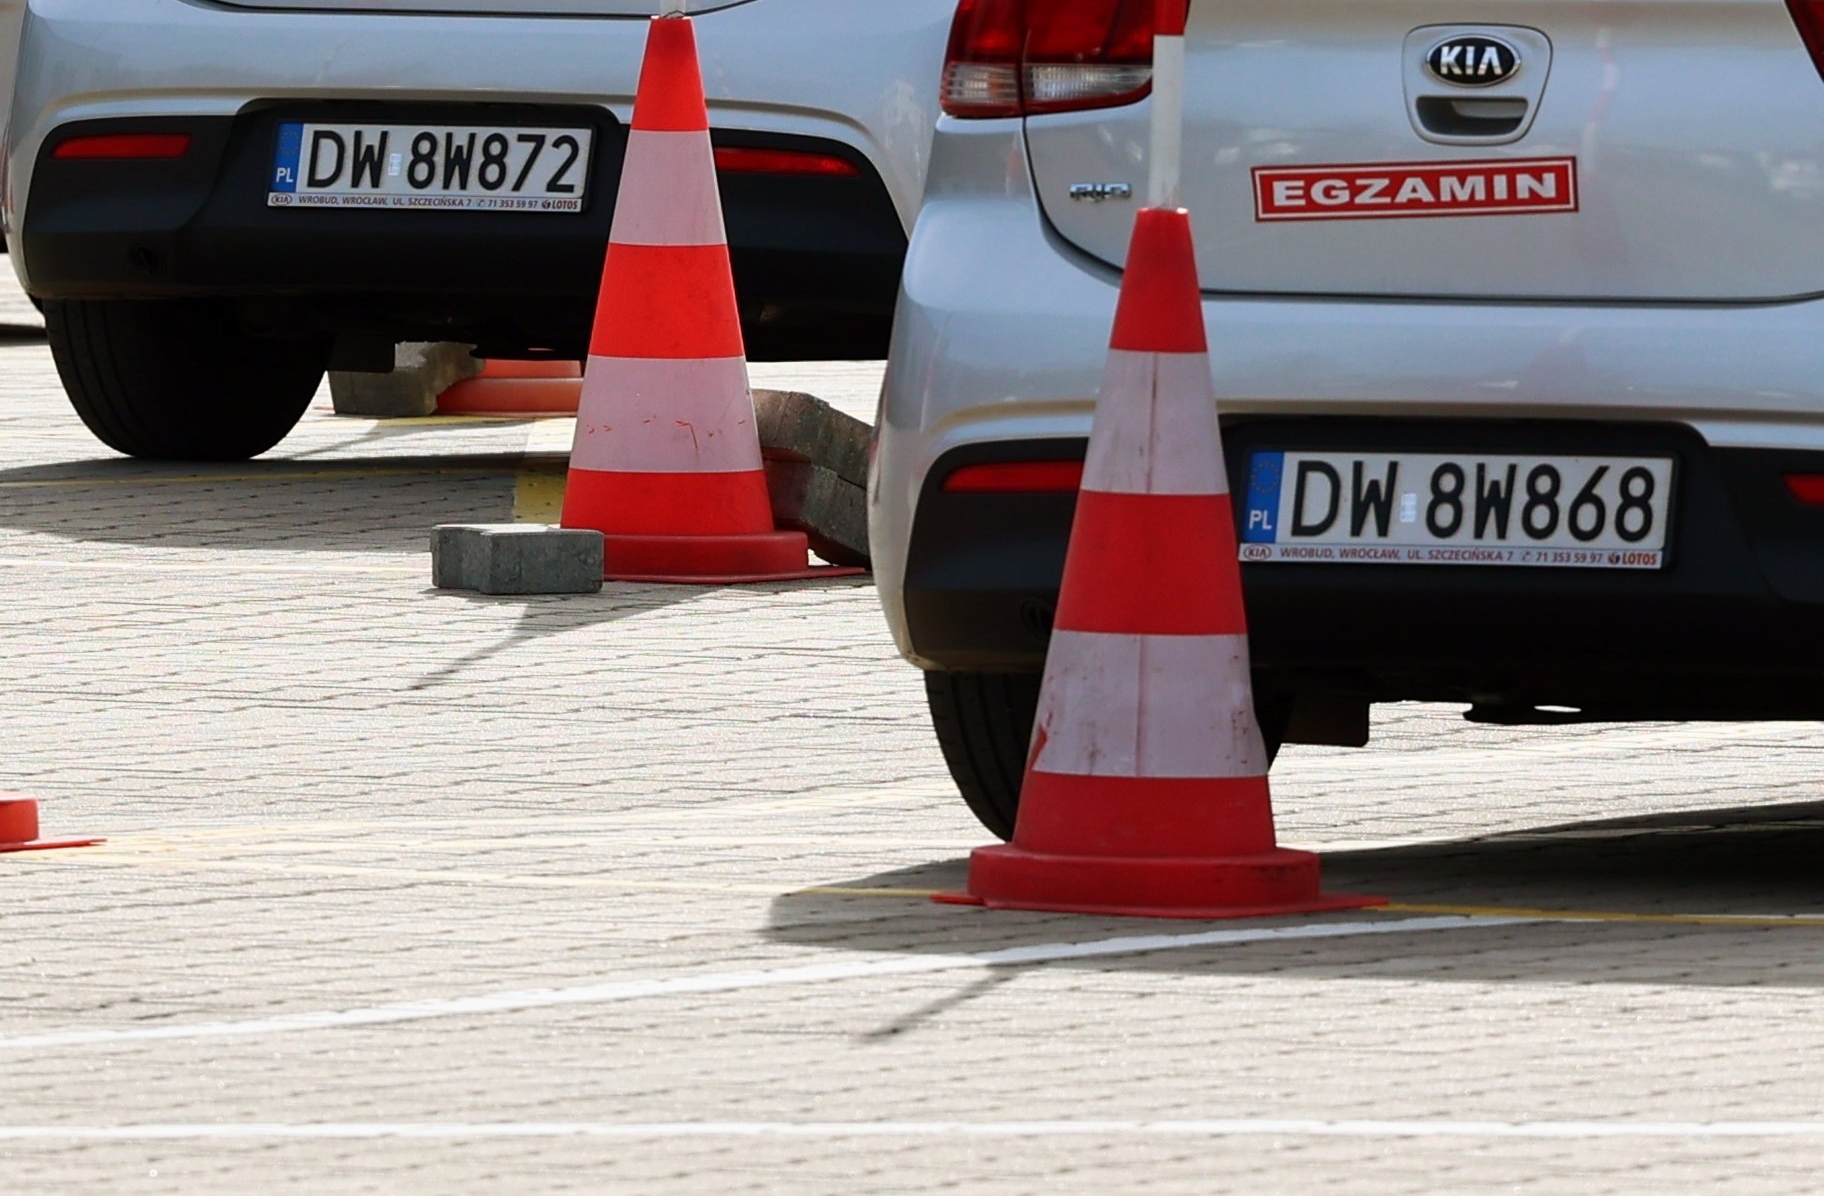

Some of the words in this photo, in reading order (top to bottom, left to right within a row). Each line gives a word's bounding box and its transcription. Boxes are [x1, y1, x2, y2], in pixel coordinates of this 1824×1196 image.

[1440, 45, 1503, 75] KIA
[307, 129, 389, 189] DW
[407, 131, 580, 193] 8W872
[276, 167, 294, 183] PL
[1272, 172, 1557, 206] EGZAMIN
[551, 199, 578, 209] LOTOS
[1290, 459, 1399, 538] DW
[1426, 461, 1656, 543] 8W868
[1248, 509, 1273, 530] PL
[1427, 547, 1503, 561] SZCZECIŃSKA
[1506, 551, 1514, 561] 7
[1536, 551, 1547, 562] 71
[1552, 552, 1571, 562] 353
[1574, 552, 1587, 563] 59
[1590, 552, 1603, 563] 97
[1622, 552, 1657, 565] LOTOS
